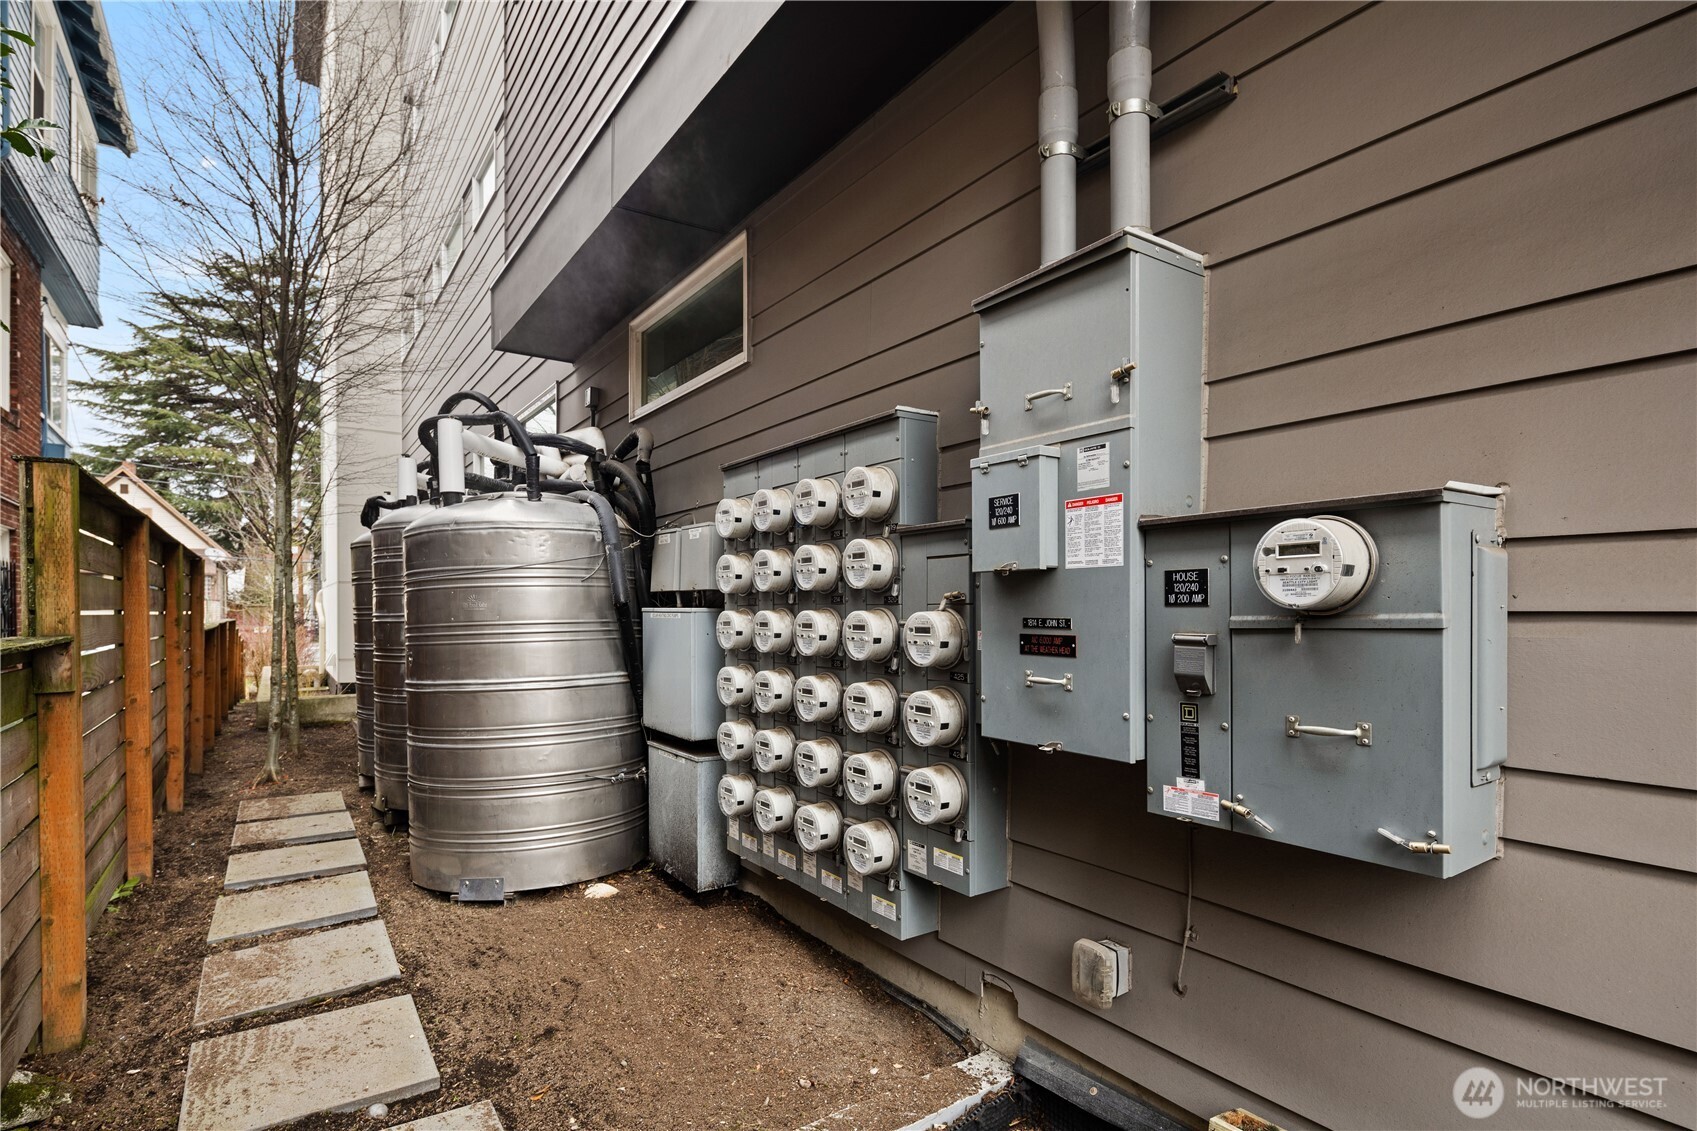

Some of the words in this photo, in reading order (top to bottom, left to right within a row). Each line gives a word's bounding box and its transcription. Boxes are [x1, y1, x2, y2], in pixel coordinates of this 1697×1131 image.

[994, 496, 1013, 506] SERVICE
[995, 506, 1013, 515] 120/240
[998, 516, 1006, 524] 600
[1008, 515, 1017, 523] AMP
[1173, 572, 1199, 581] HOUSE
[1174, 583, 1199, 592] 120/240
[1178, 595, 1189, 603] 200
[1192, 594, 1205, 602] AMP
